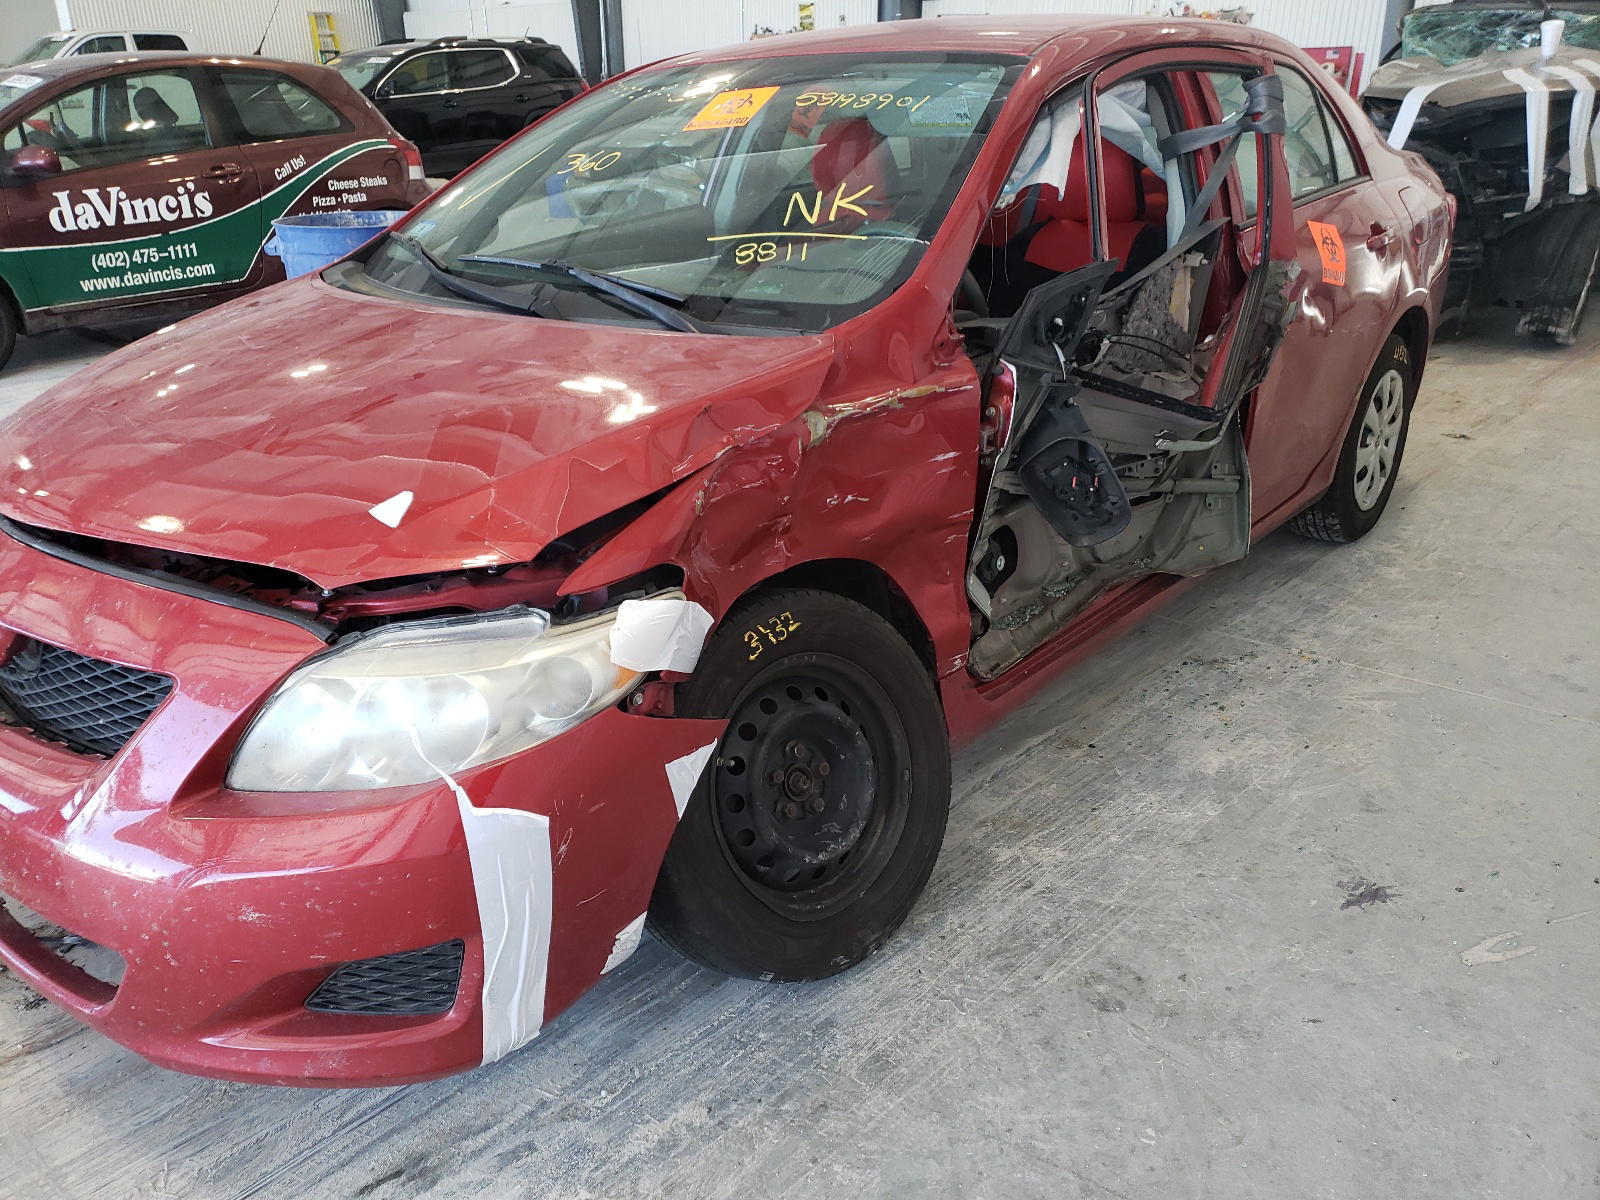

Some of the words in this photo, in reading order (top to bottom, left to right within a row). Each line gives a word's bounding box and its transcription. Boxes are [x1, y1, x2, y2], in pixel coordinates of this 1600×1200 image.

[274, 163, 293, 180] Call
[291, 154, 307, 171] Us!
[557, 150, 621, 174] 360
[327, 179, 359, 191] Cheese
[359, 175, 388, 187] Steaks
[48, 181, 214, 232] daVinci's
[312, 195, 336, 207] Pizza
[342, 191, 368, 204] Pasta
[783, 182, 875, 226] NK
[91, 250, 131, 273] (402)
[133, 242, 198, 265] 475-1111
[79, 262, 216, 292] www.davincis.com
